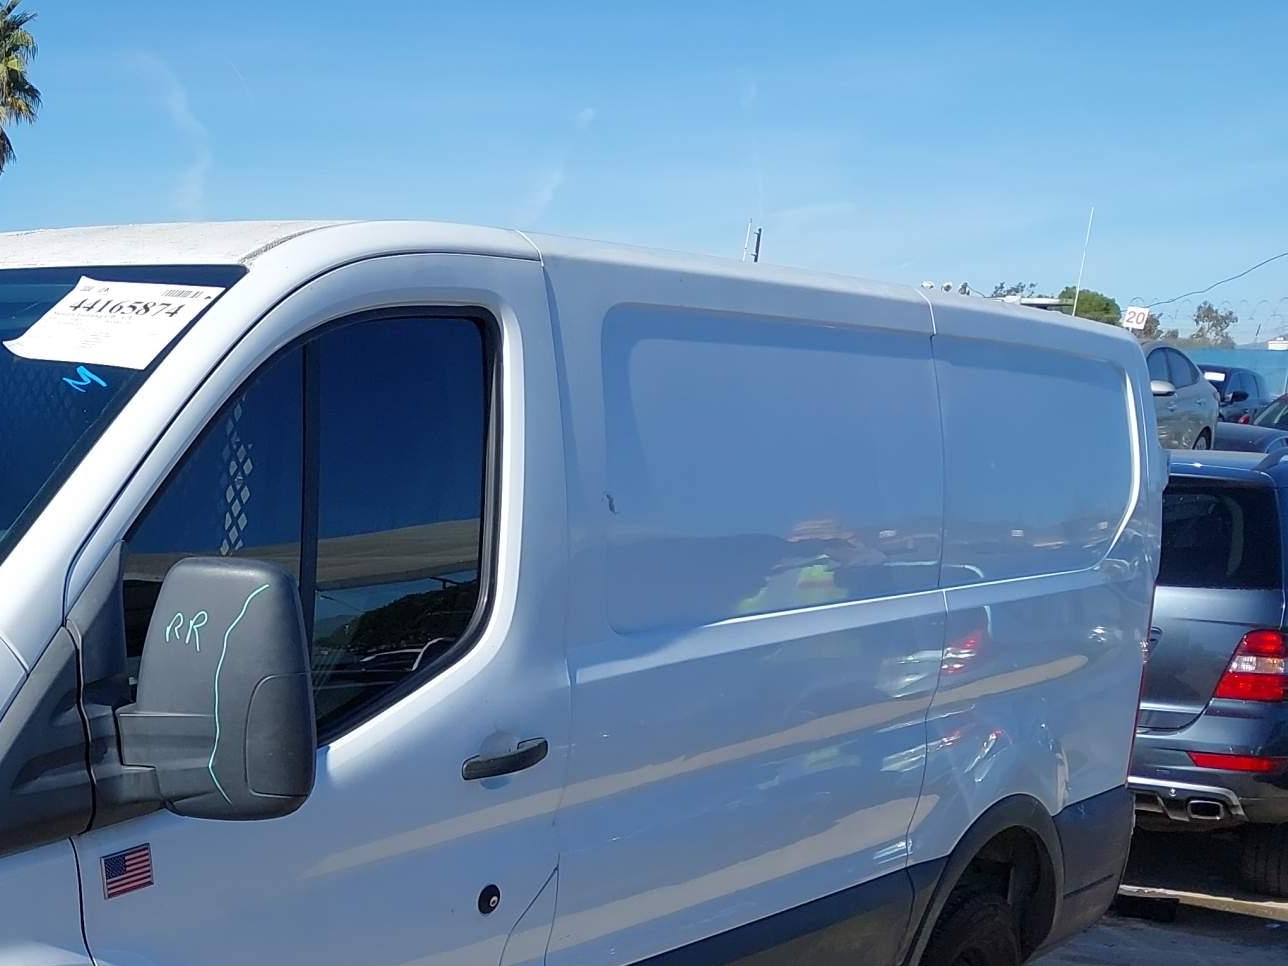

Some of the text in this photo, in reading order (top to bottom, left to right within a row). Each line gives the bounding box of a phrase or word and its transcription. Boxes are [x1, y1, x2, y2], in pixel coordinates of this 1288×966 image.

[69, 298, 186, 318] 44165874
[1126, 310, 1146, 325] 20
[165, 610, 209, 652] RR
